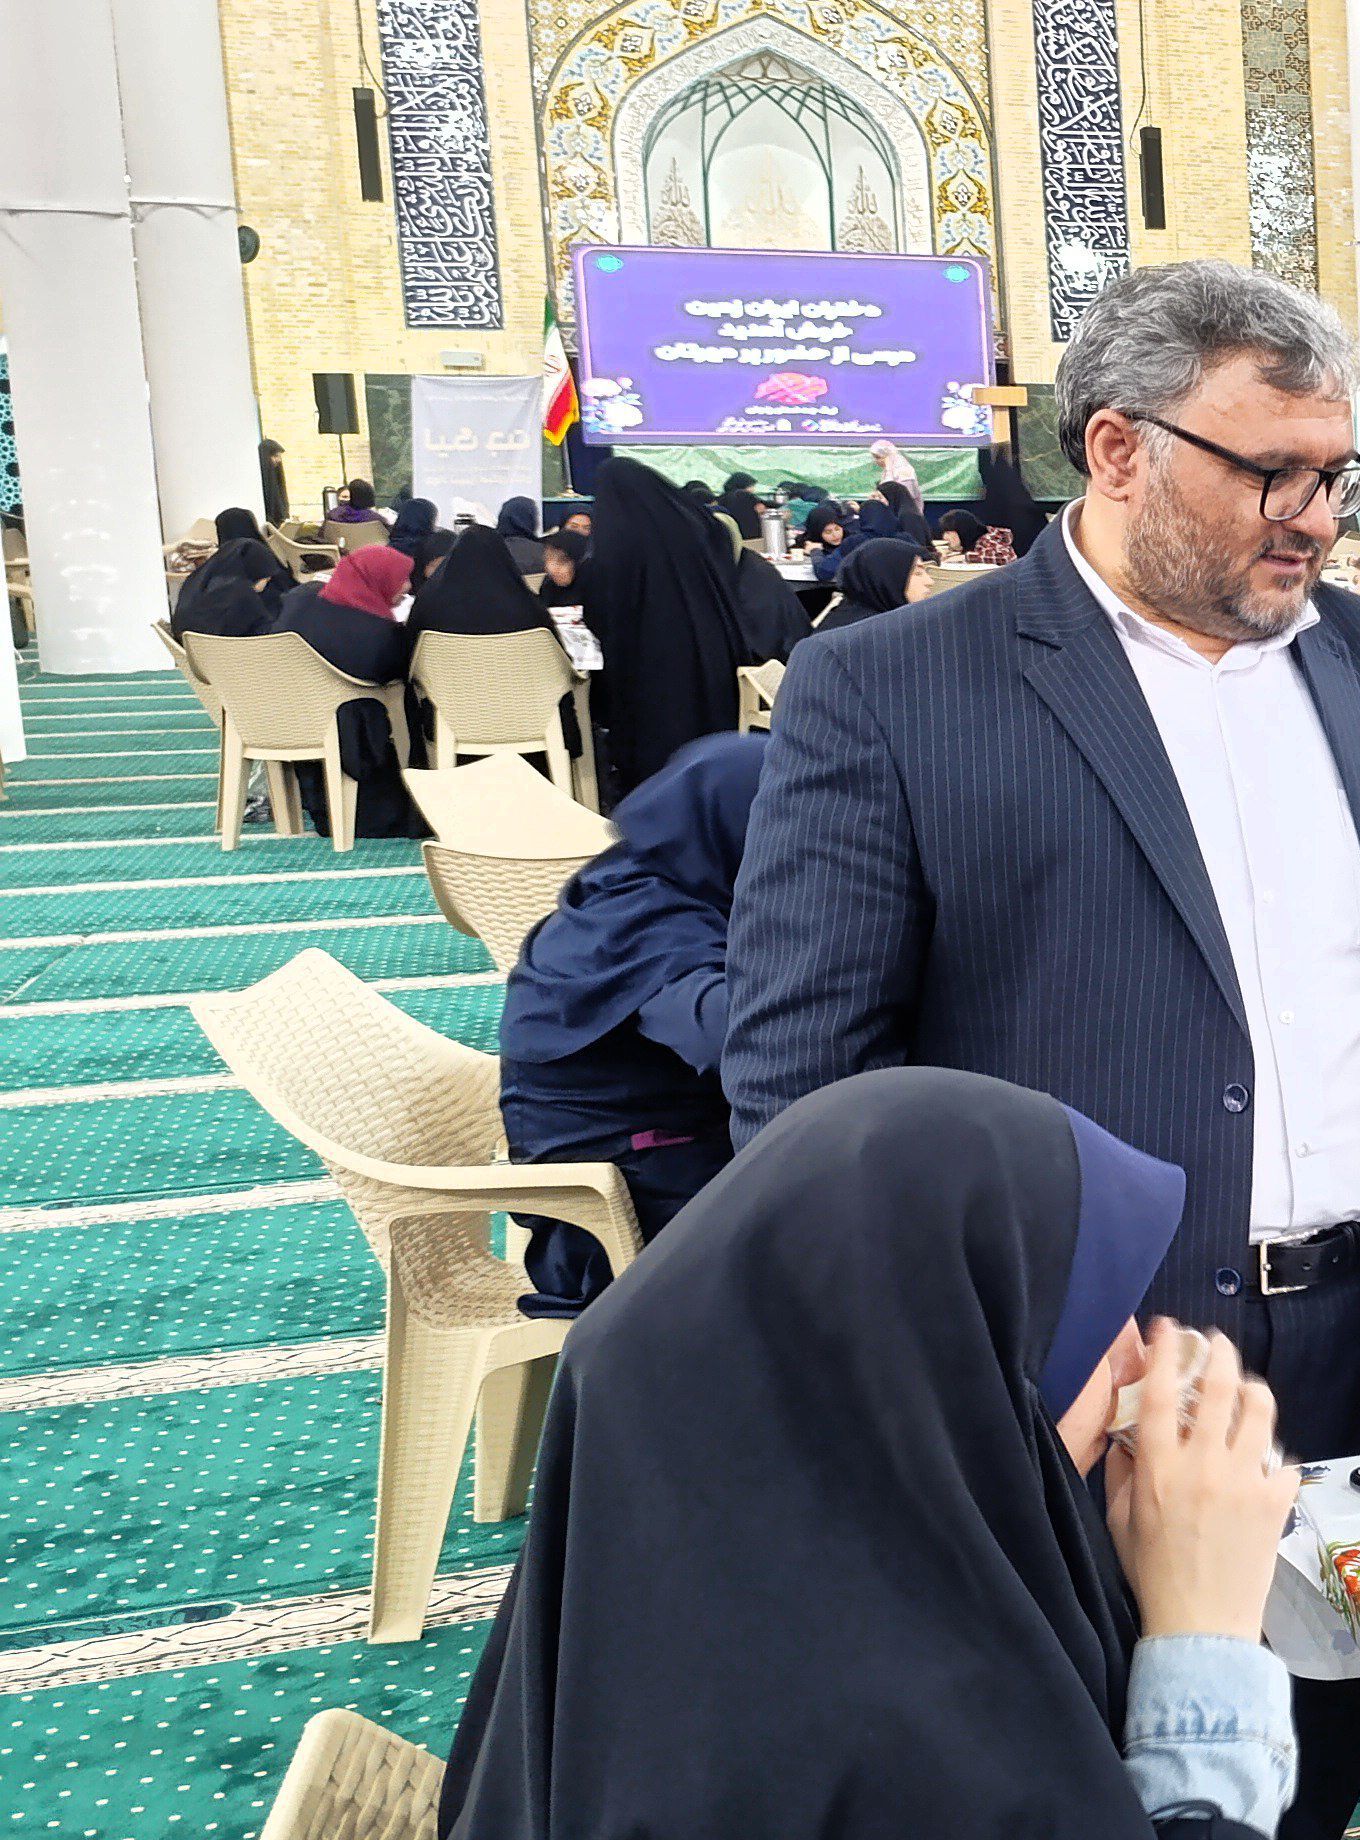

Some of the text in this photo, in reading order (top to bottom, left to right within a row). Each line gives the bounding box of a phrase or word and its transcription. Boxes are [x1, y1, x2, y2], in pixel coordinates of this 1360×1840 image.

[745, 299, 799, 318] ایران
[718, 318, 854, 342] خوش آمدید
[830, 346, 850, 365] از
